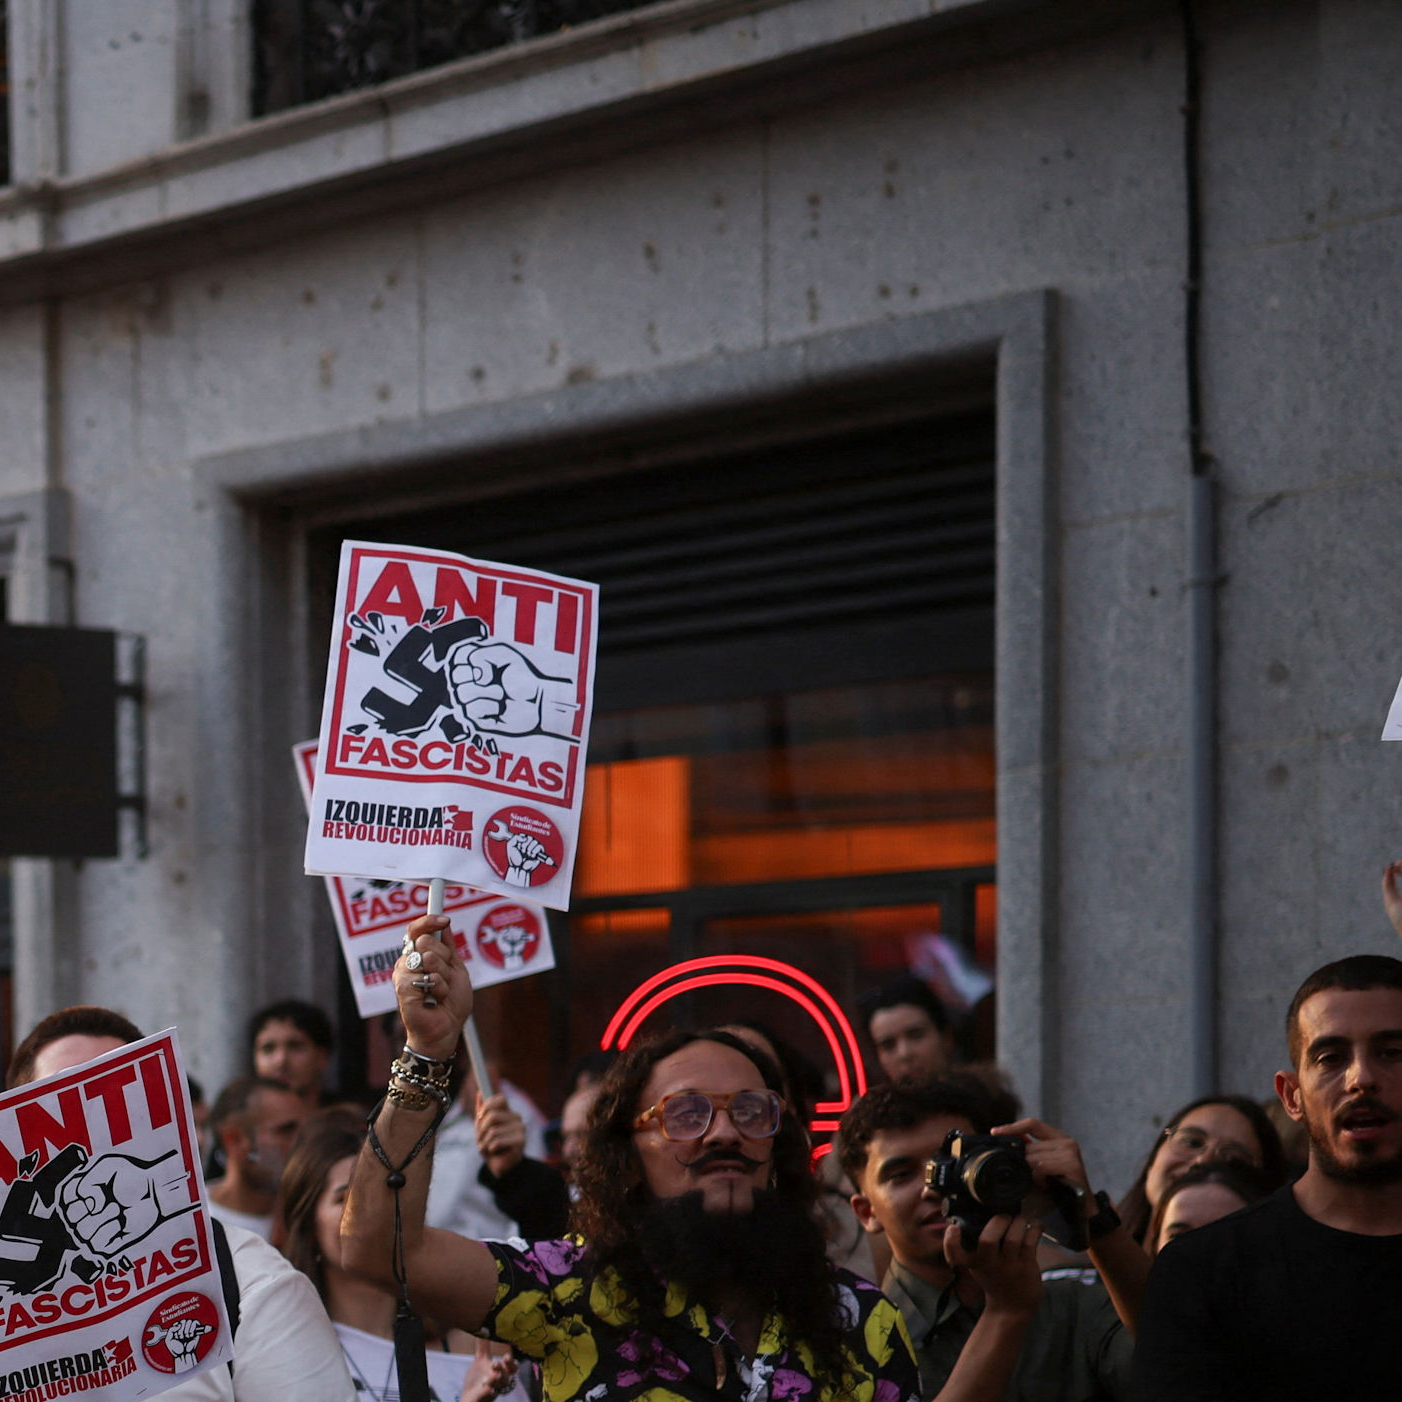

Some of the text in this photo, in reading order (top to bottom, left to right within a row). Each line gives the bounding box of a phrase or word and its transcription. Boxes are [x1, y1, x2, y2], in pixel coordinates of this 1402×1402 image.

[358, 561, 578, 655] ANTI
[340, 734, 564, 793] FASCISTAS
[323, 820, 472, 850] REVOLUCIONARIA
[325, 799, 443, 829] IZQUIERDA
